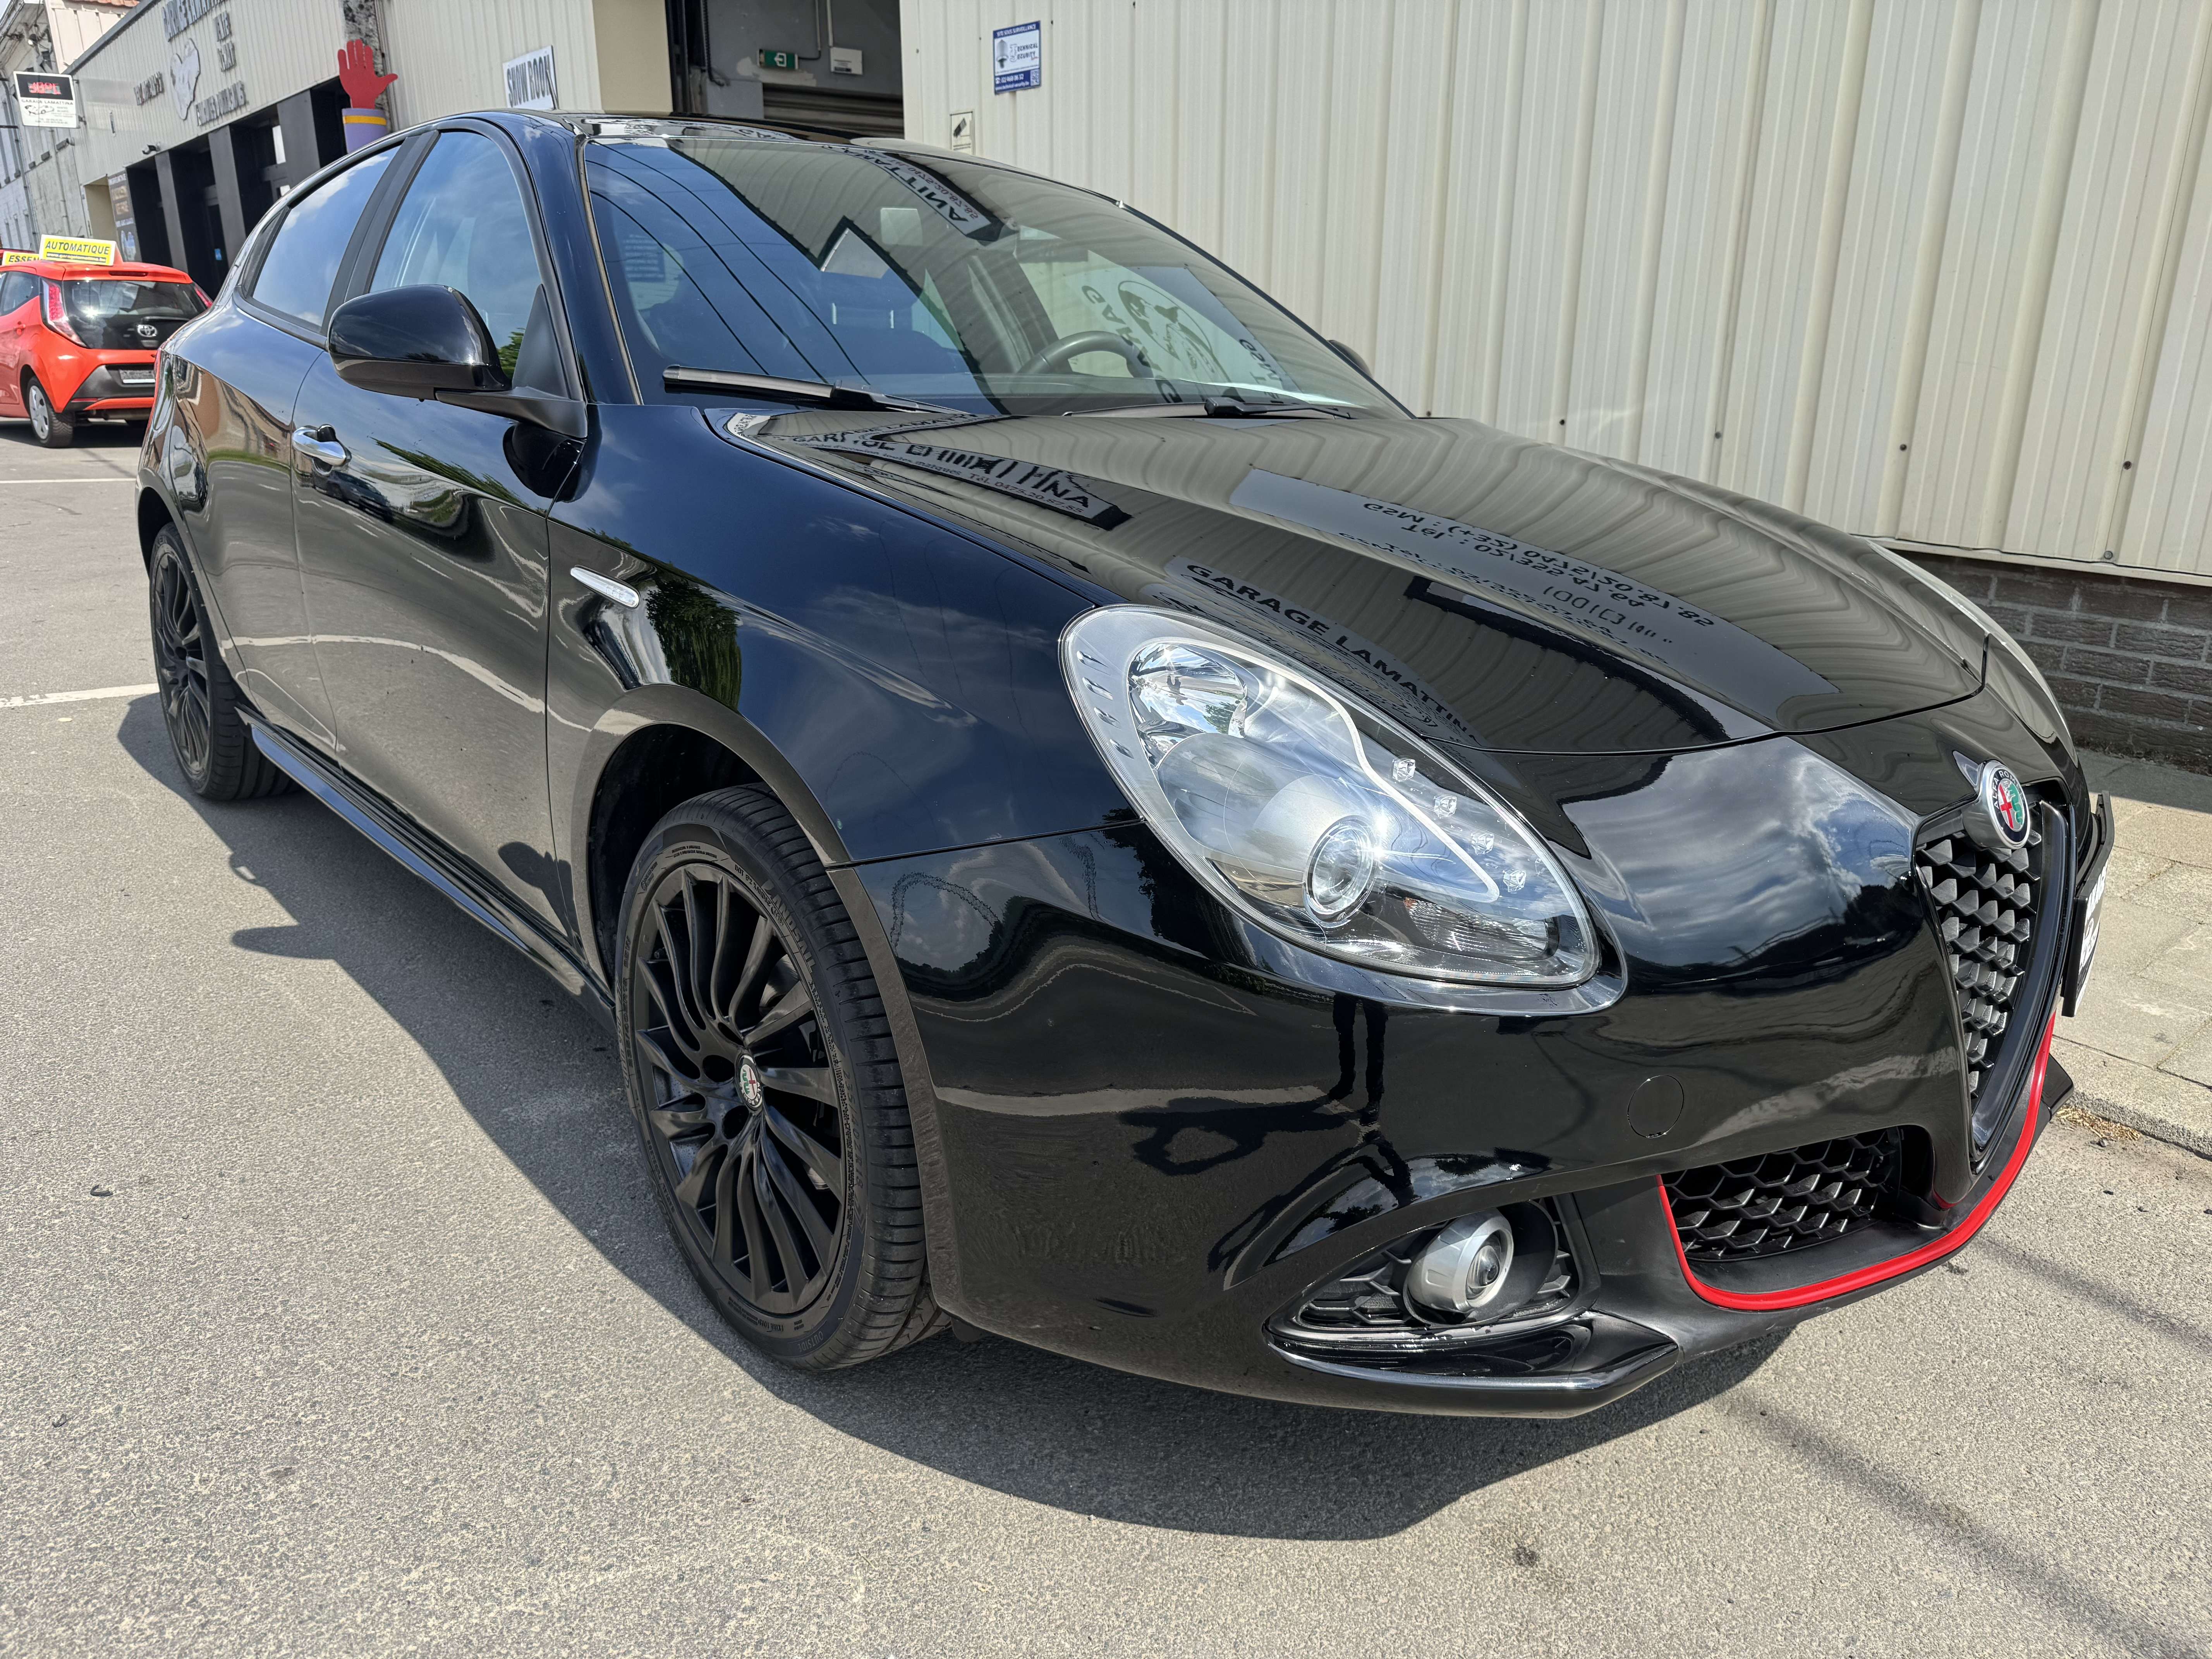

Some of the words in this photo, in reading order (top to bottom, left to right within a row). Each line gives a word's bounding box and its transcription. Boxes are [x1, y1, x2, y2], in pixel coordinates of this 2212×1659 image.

[507, 62, 529, 108] SHOW
[45, 241, 110, 255] AUTOMATIQUE
[1187, 564, 1330, 636] GARAGE
[1992, 777, 2000, 810] ALFA
[797, 1330, 824, 1352] OUTSIDE
